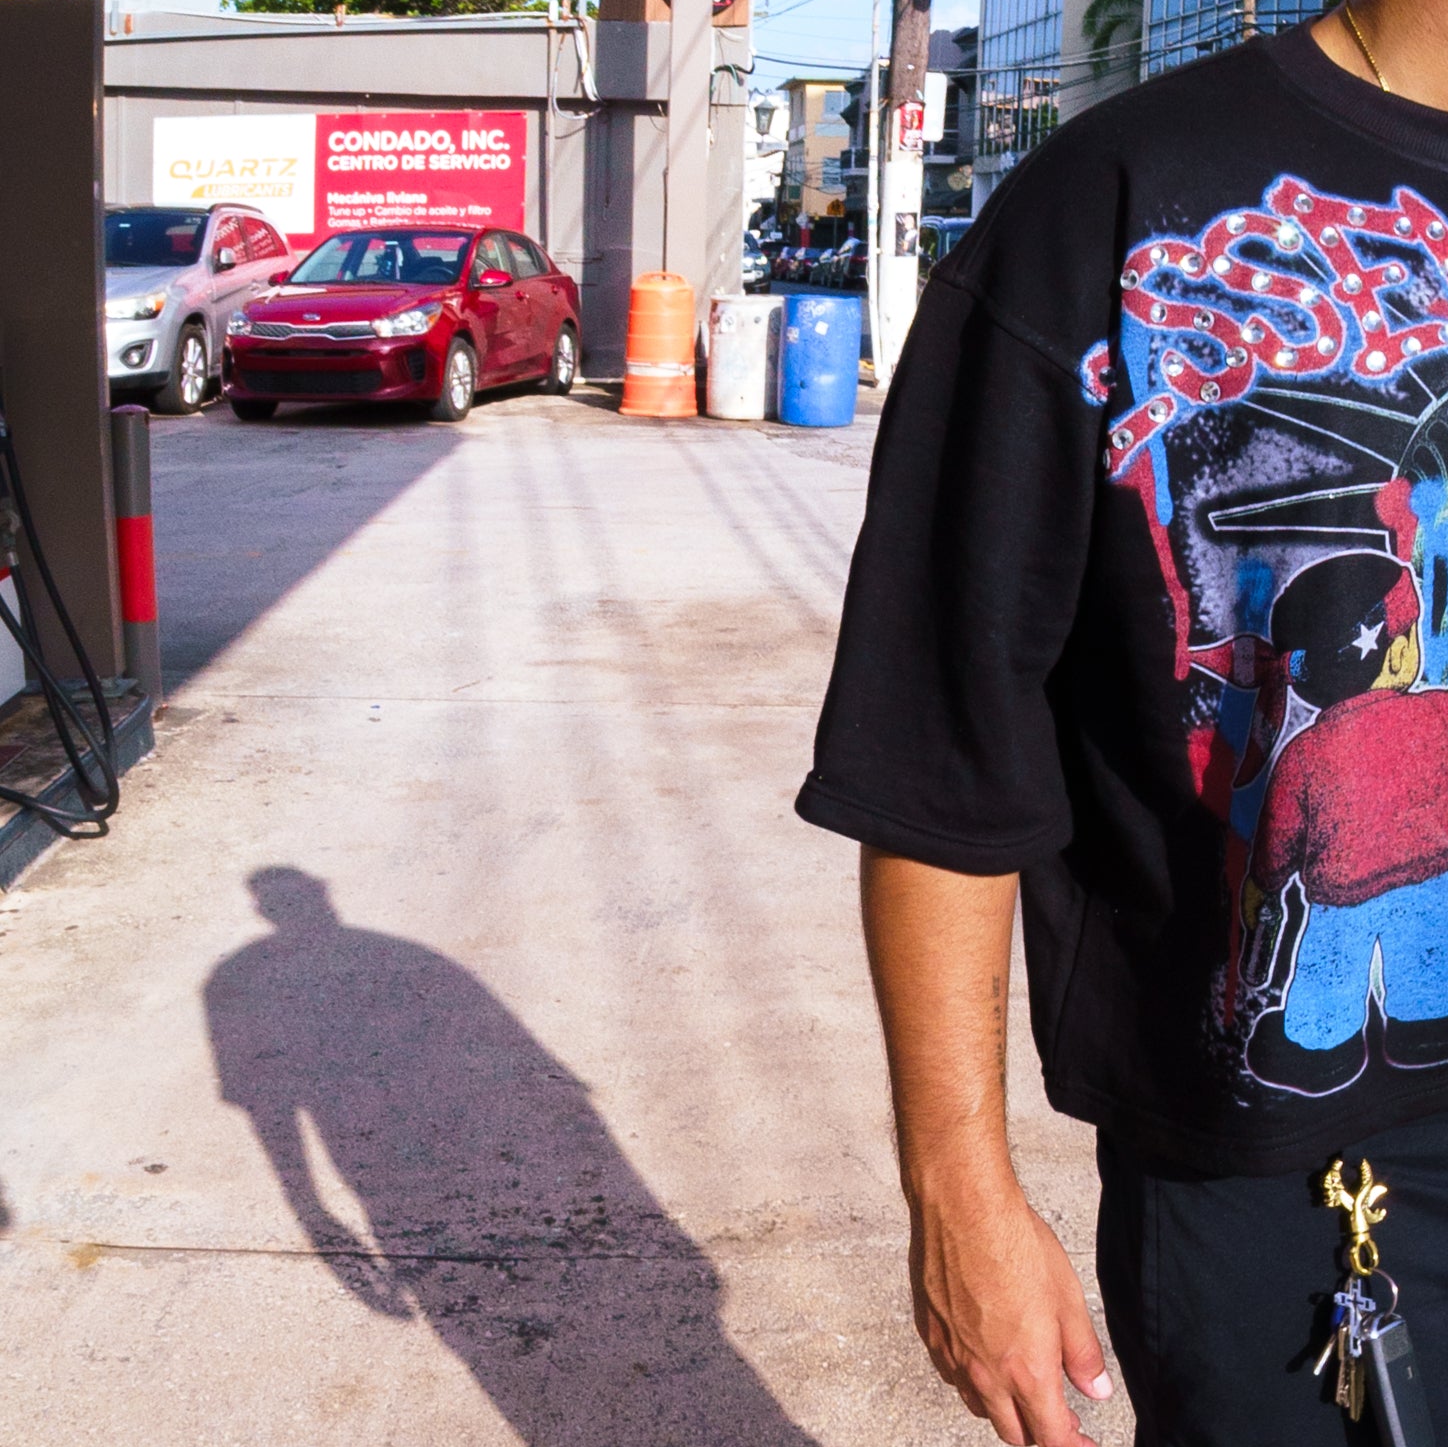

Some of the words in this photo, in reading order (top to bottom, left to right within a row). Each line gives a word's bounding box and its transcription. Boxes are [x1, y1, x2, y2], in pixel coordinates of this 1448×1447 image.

[328, 130, 456, 154] CONDADO,
[461, 129, 510, 151] INC.
[169, 158, 298, 181] QUARTZ
[328, 155, 398, 171] CENTRO
[401, 155, 426, 170] DE
[429, 154, 511, 170] SERVICIO
[203, 183, 291, 198] LUBRICANTS
[374, 205, 412, 216] Cambio
[413, 205, 427, 216] de
